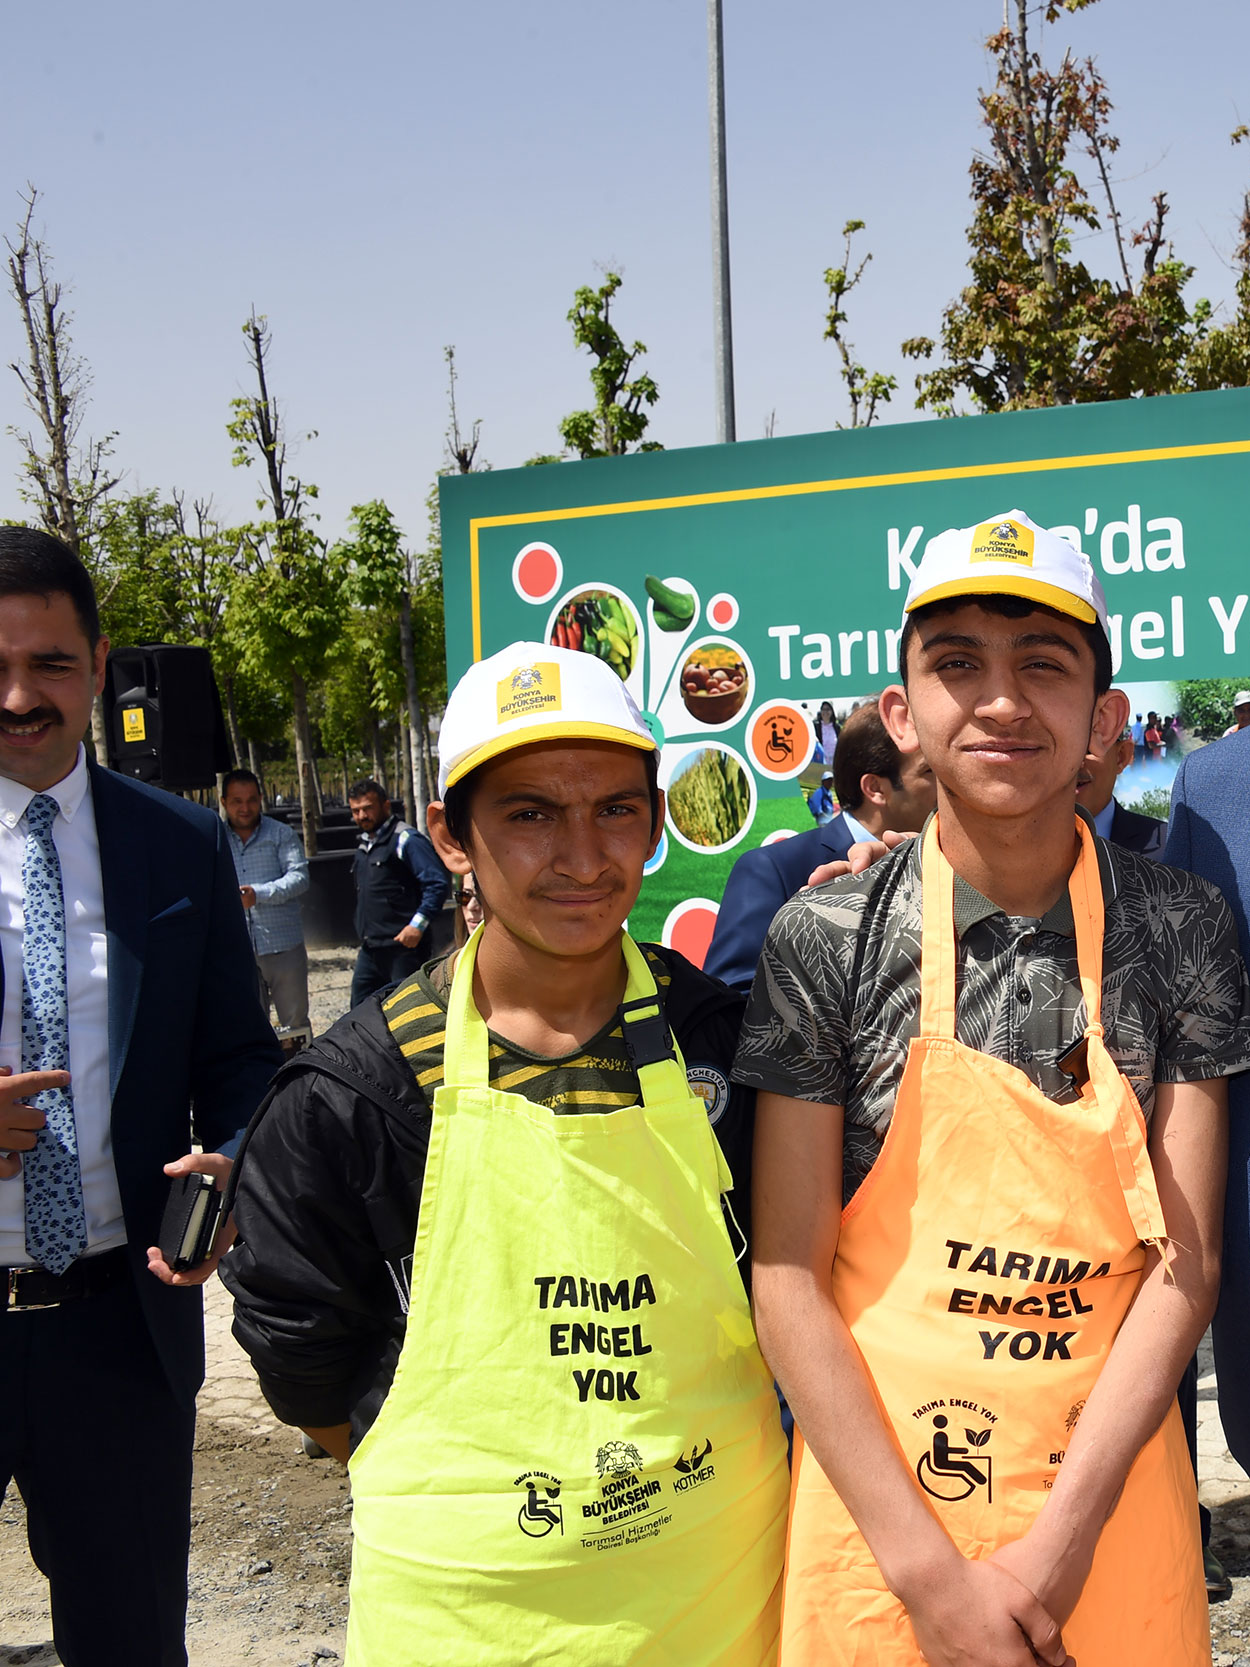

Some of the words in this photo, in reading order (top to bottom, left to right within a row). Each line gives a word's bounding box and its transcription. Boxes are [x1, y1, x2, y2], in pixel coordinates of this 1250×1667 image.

[989, 540, 1016, 548] KONYA
[513, 690, 541, 700] KONYA
[687, 1069, 727, 1092] NCHESTER
[947, 1287, 1094, 1319] ENGEL
[550, 1322, 653, 1358] ENGEL
[978, 1330, 1077, 1361] YOK
[572, 1369, 641, 1403] YOK
[911, 1399, 946, 1420] TARIMA
[949, 1398, 978, 1412] ENGEL
[980, 1407, 998, 1424] YOK
[602, 1474, 640, 1498] KONYA
[672, 1465, 715, 1493] KOTMER
[582, 1480, 662, 1518] BÜYÜKŞEHİR
[602, 1499, 650, 1525] BELEDİYESİ
[580, 1529, 625, 1548] Tarımsal
[628, 1513, 673, 1537] Hizmetler
